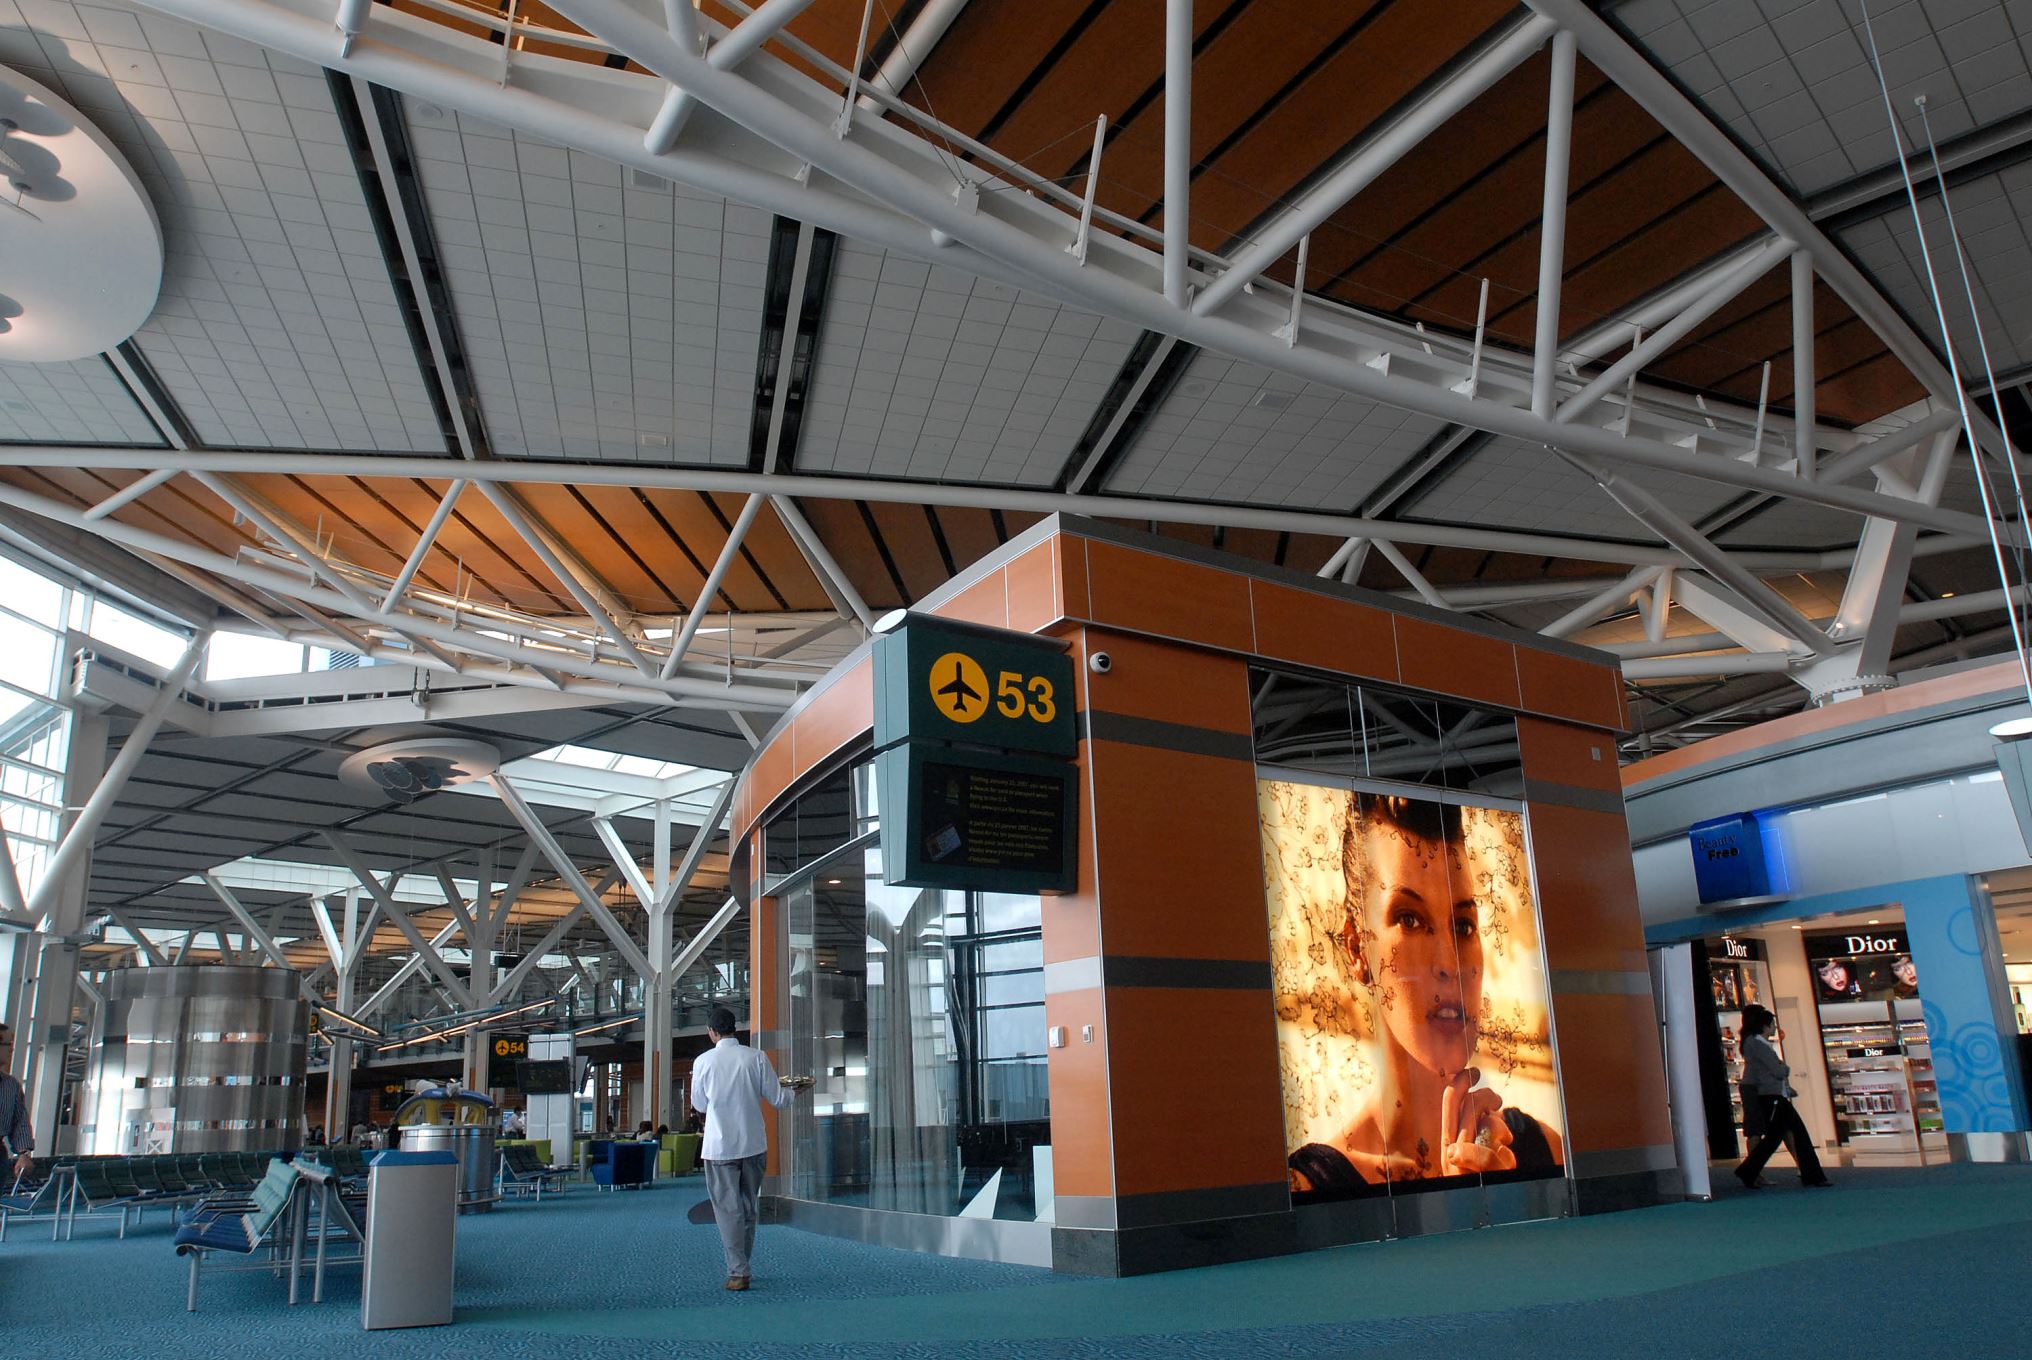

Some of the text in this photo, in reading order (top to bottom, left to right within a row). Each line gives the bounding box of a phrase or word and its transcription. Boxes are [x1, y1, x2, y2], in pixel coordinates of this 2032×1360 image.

[996, 671, 1056, 723] 53
[1697, 833, 1737, 851] Beauty
[1708, 847, 1739, 861] Free
[1725, 939, 1748, 957] Dior
[1846, 936, 1898, 954] Dior
[510, 1042, 525, 1054] 54
[1864, 1048, 1884, 1057] Dior
